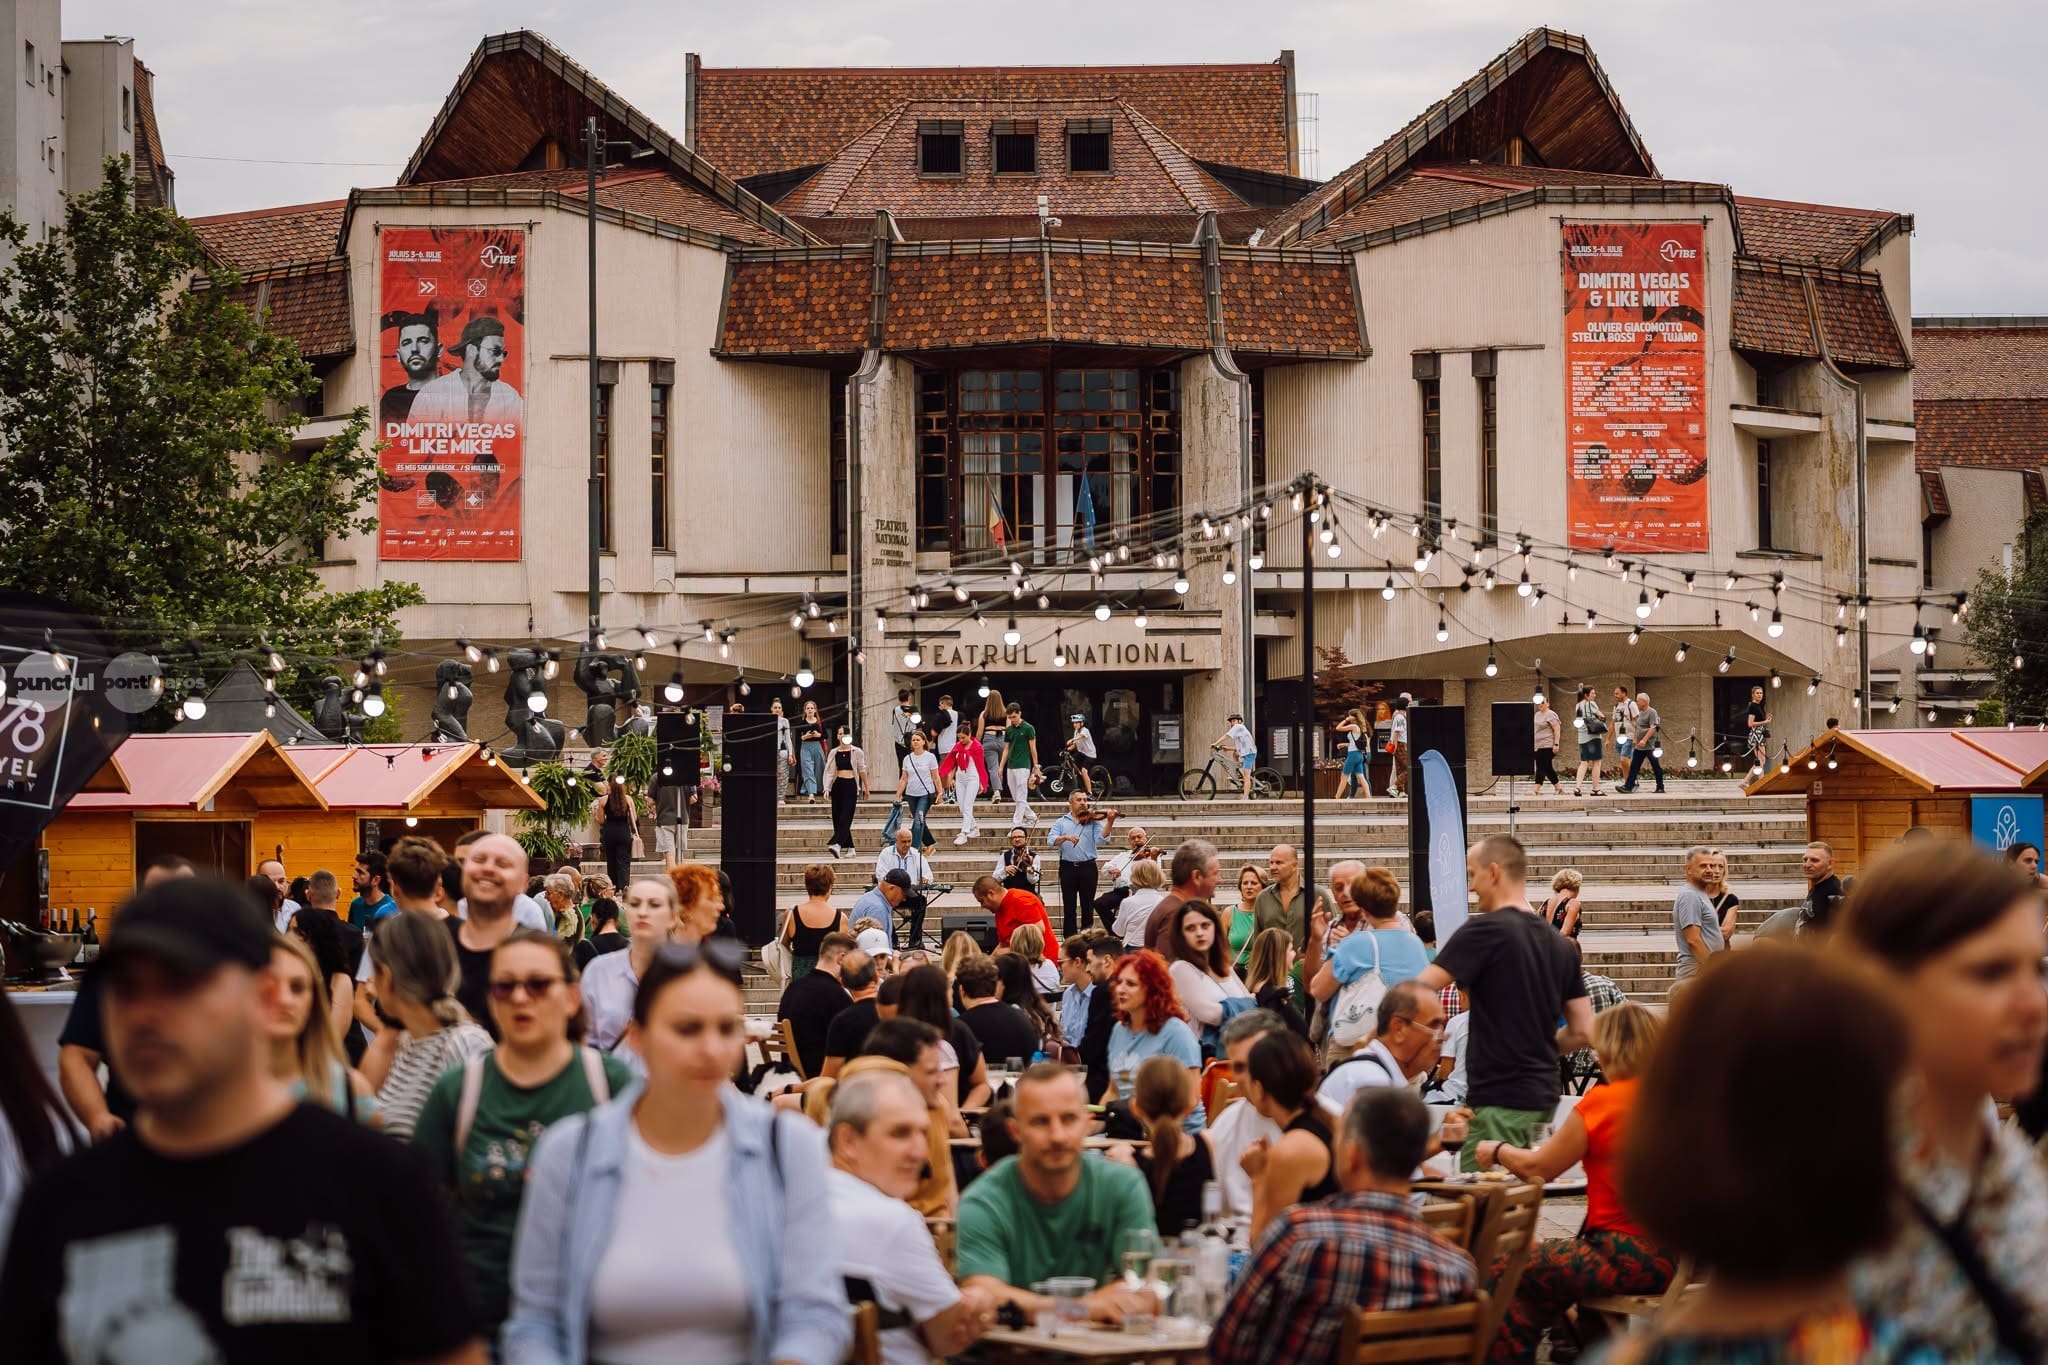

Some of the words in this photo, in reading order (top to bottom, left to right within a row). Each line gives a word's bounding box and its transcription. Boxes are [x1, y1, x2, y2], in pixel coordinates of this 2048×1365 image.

[1578, 272, 1635, 289] DIMITRI
[1640, 272, 1690, 289] VEGAS
[1590, 291, 1603, 307] &
[1606, 290, 1639, 307] LIKE
[1642, 290, 1680, 307] MIKE
[1587, 322, 1622, 333] OLIVIER
[1624, 322, 1683, 333] GIACOMOTTO
[1572, 332, 1606, 342] STELLA
[1607, 332, 1635, 342] BOSSI
[386, 422, 453, 438] DIMITRI
[454, 423, 516, 439] VEGAS
[409, 439, 449, 454] LIKE
[450, 439, 493, 455] MIKE
[876, 519, 909, 533] TEATRUL
[916, 644, 1037, 665] TEATRUL
[1064, 643, 1195, 665] NATIONAL
